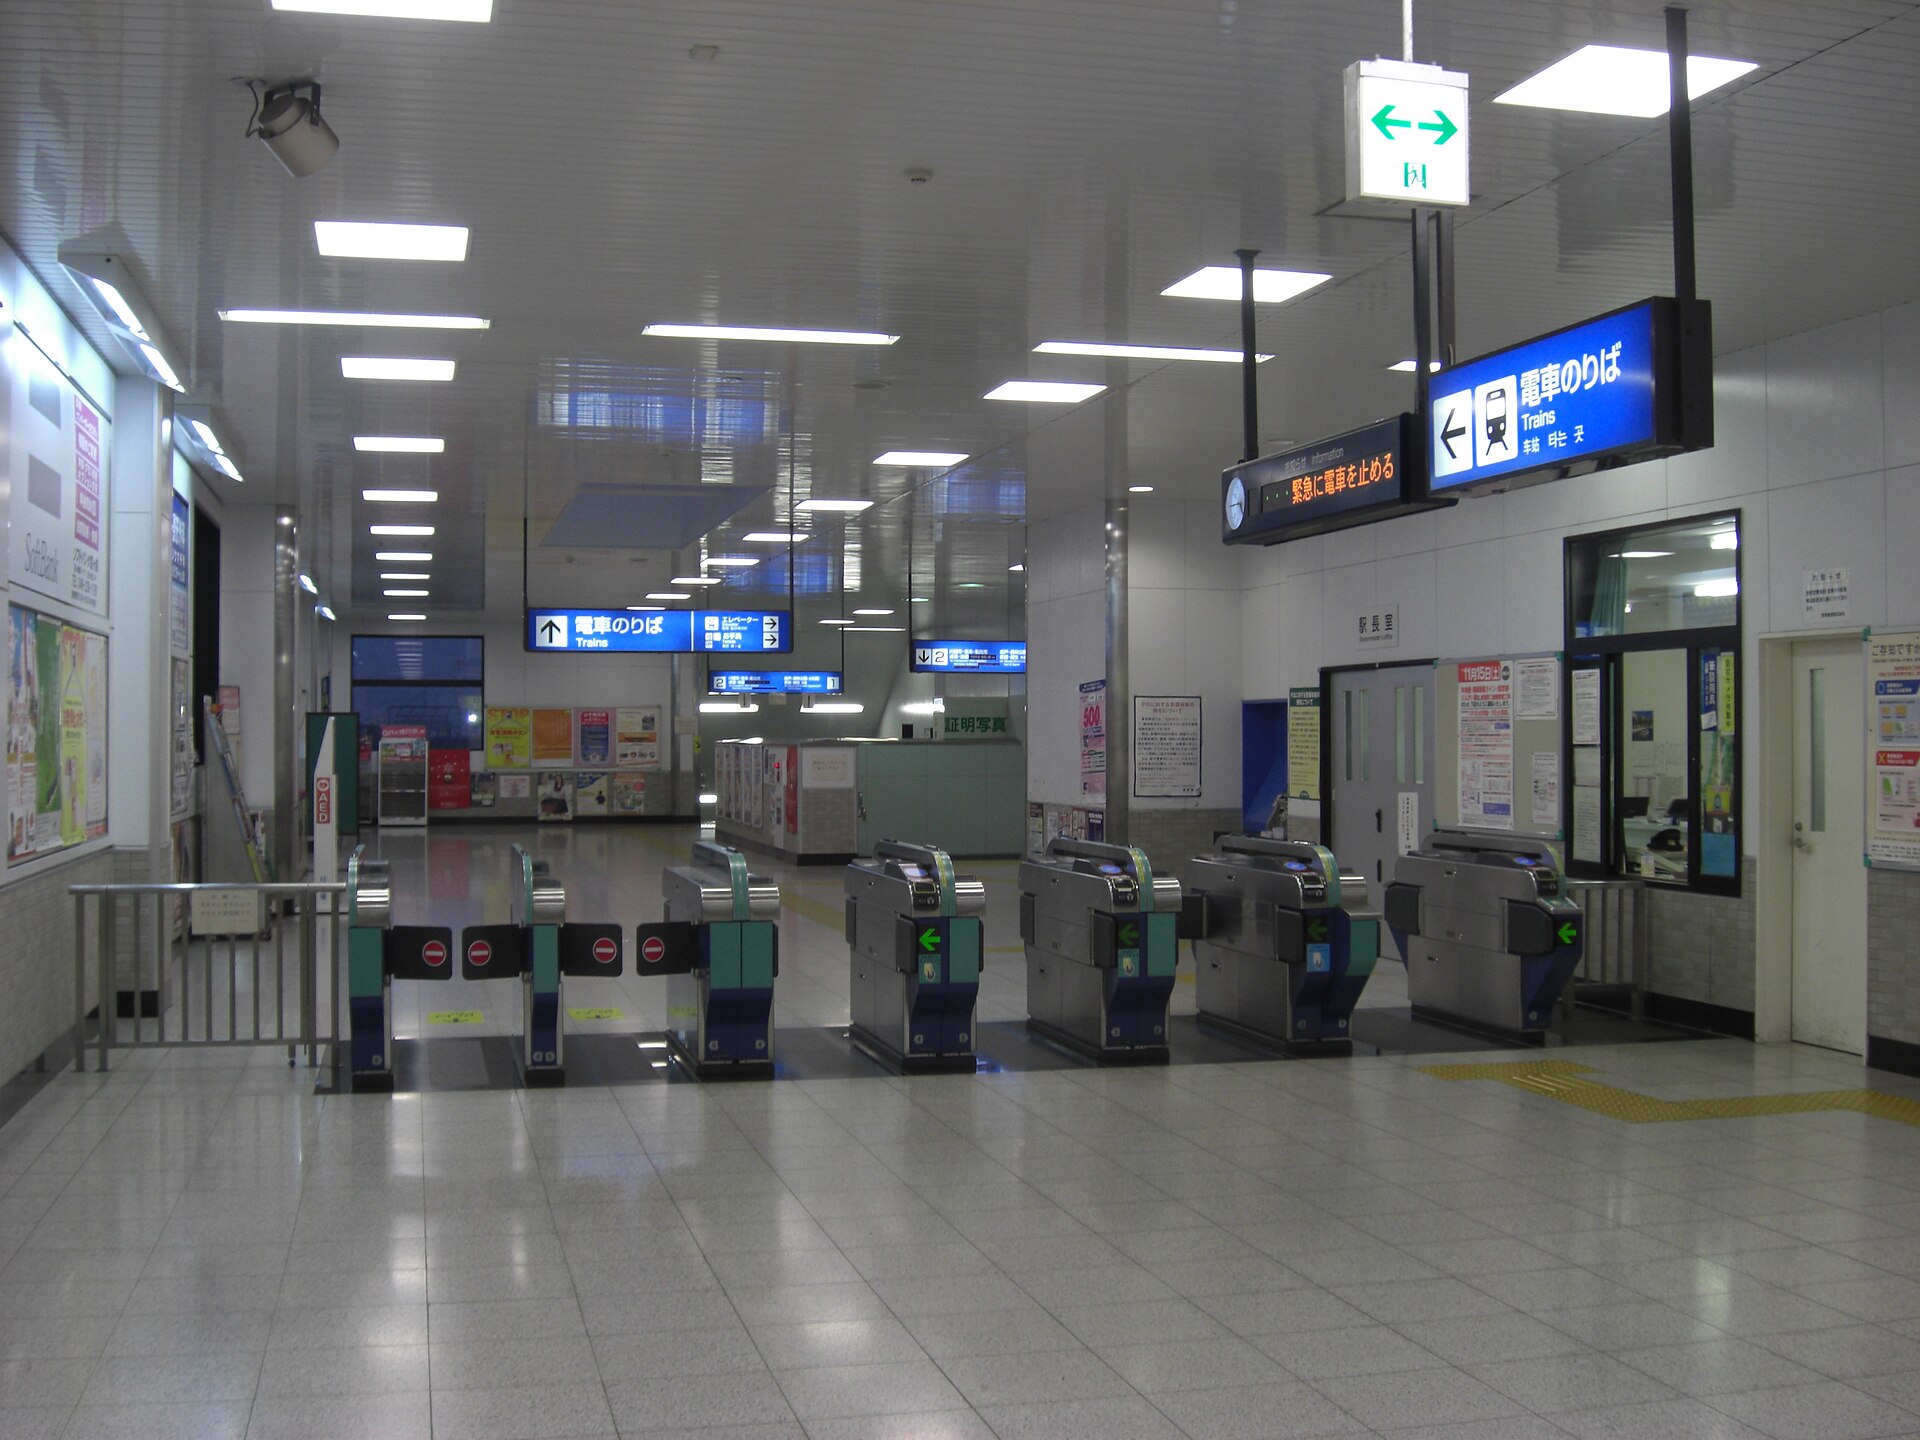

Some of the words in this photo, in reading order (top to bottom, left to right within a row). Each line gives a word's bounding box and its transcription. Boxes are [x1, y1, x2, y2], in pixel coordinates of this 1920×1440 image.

[1520, 341, 1622, 408] 電車のりば
[1521, 409, 1556, 432] Trains
[1548, 430, 1568, 449] 타는
[1311, 447, 1344, 465] Information
[1292, 453, 1394, 504] 緊急に電車を止める
[574, 615, 664, 635] 電車のりば
[1359, 614, 1392, 634] 駅長室
[576, 637, 608, 648] Trains
[935, 651, 945, 663] 2
[716, 678, 724, 688] 2
[944, 717, 1007, 733] 証明写真
[1083, 704, 1100, 728] 500
[319, 792, 328, 820] AED
